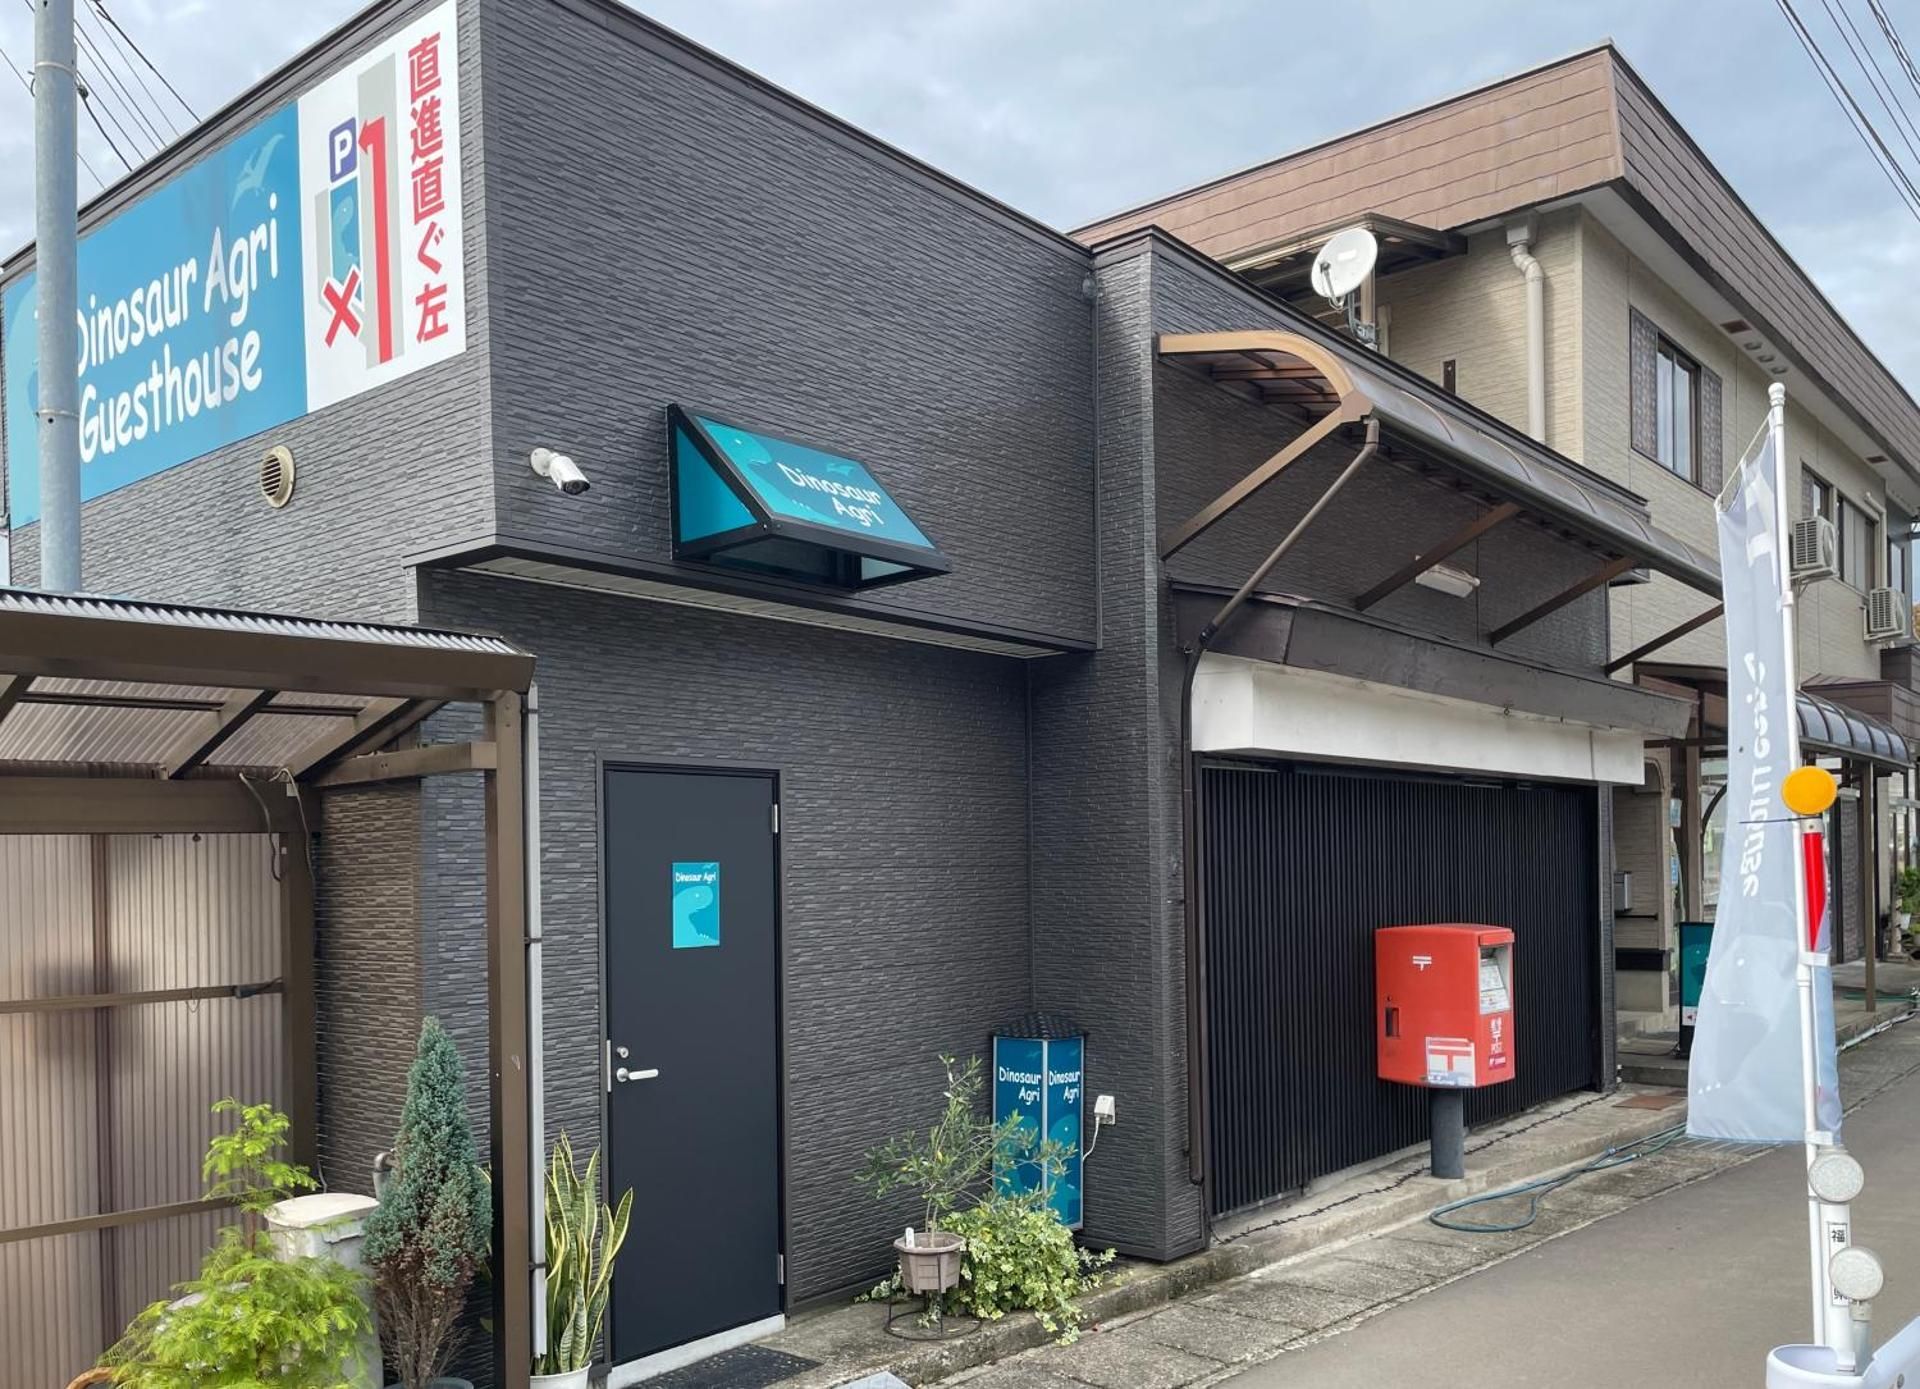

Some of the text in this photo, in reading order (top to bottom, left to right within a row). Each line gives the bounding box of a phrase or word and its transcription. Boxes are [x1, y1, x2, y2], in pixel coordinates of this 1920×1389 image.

[408, 31, 449, 344] 直進直ぐ左
[204, 192, 278, 327] Agri
[79, 330, 262, 463] Guesthouse
[776, 462, 881, 505] Dinosaur
[831, 496, 884, 527] Agri
[675, 871, 717, 884] Dinosaur Agri
[999, 1066, 1042, 1085] Dinosaur
[1049, 1070, 1081, 1086] Dinosaur
[1018, 1085, 1040, 1105] Agri
[1063, 1084, 1080, 1104] Agri
